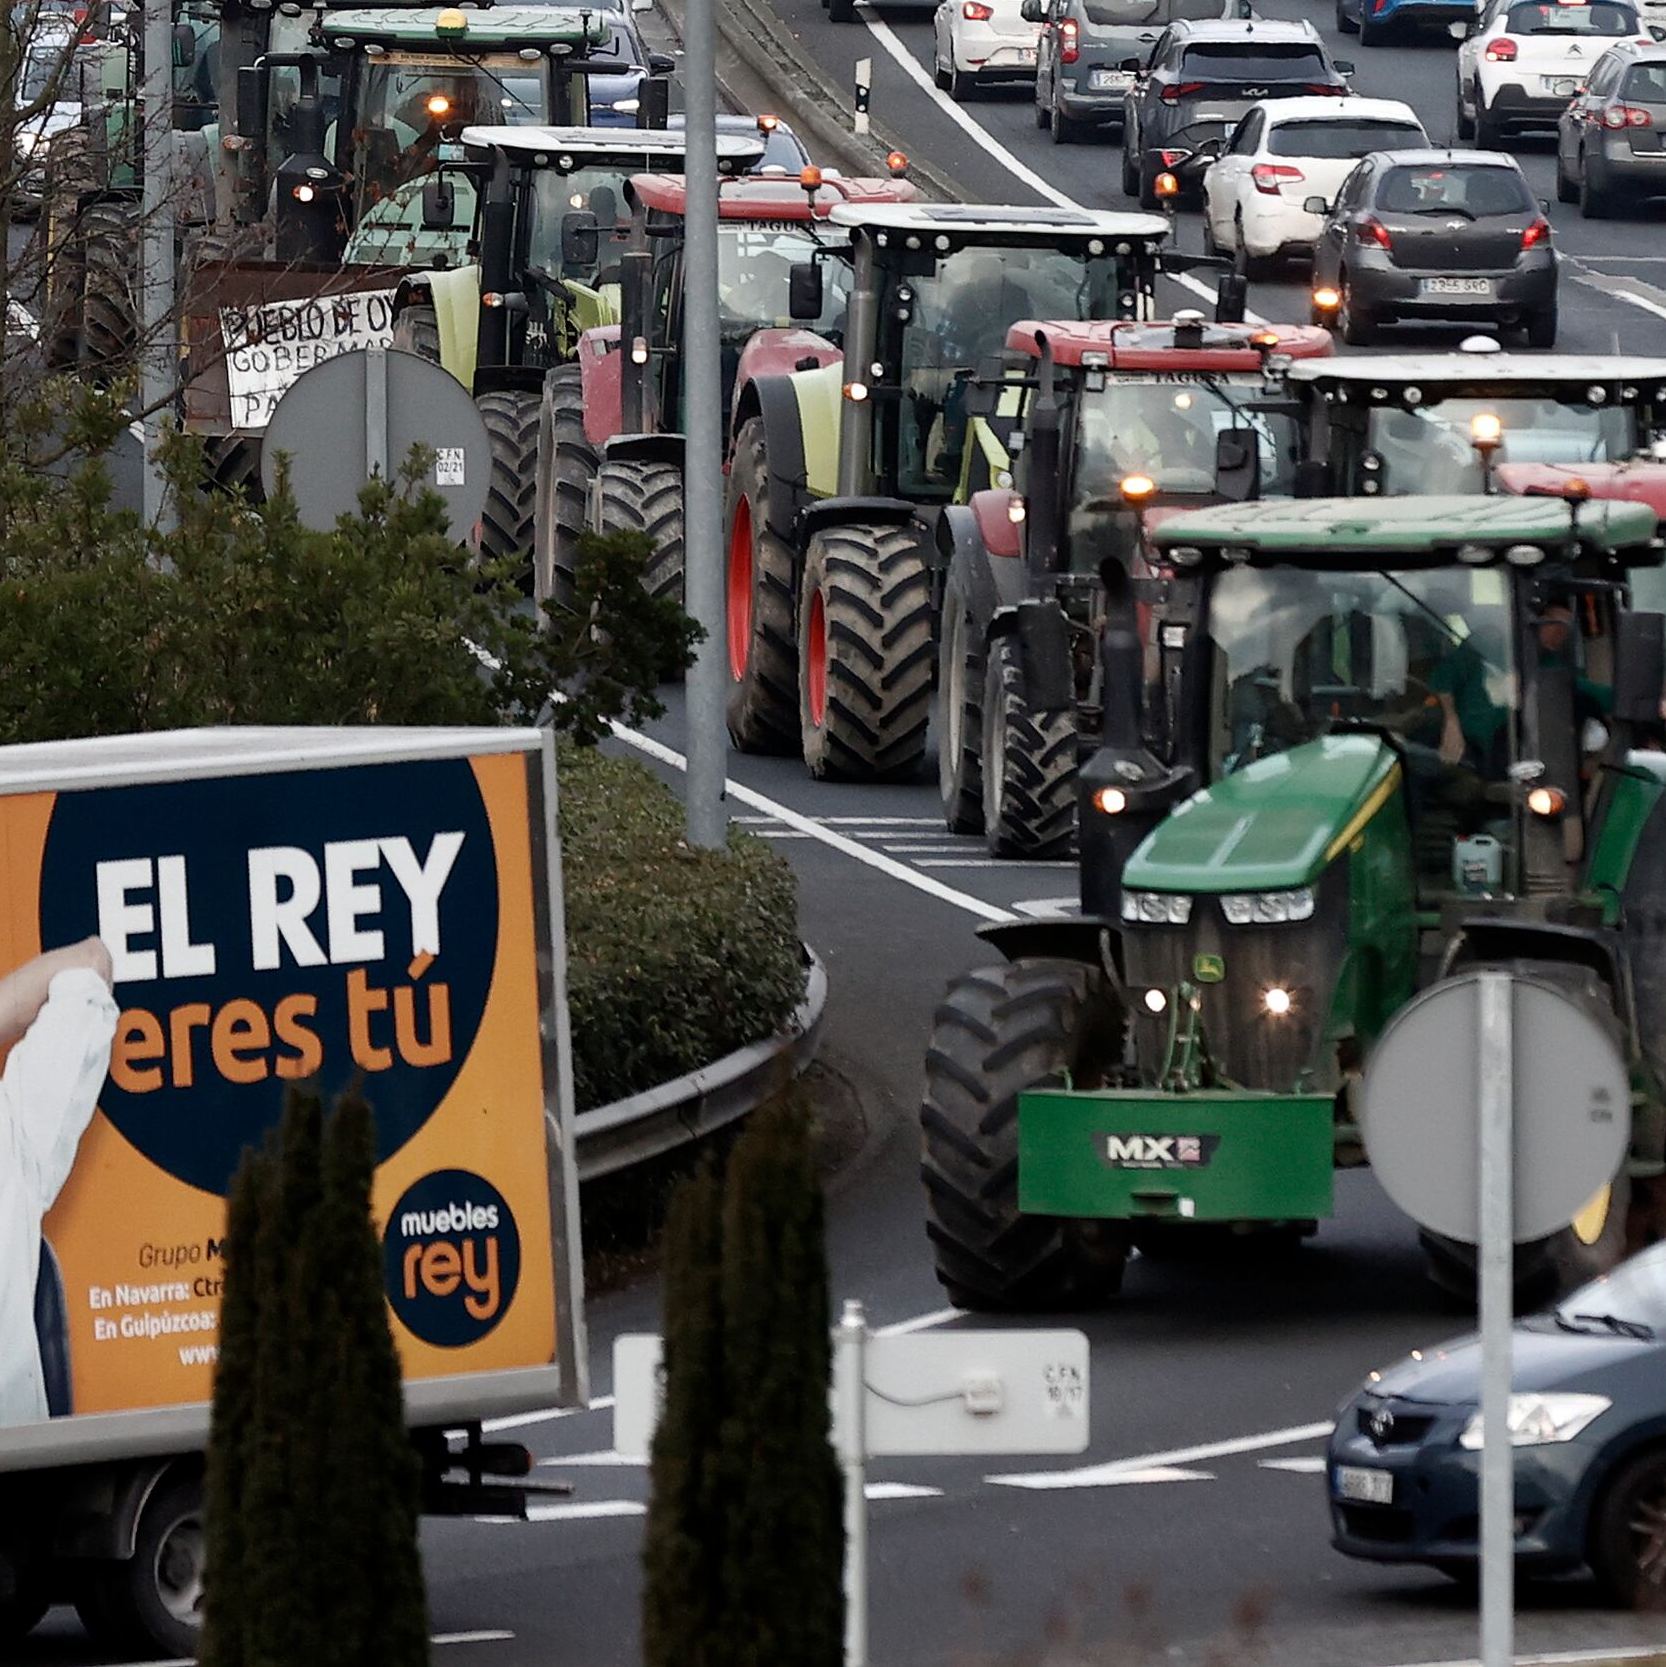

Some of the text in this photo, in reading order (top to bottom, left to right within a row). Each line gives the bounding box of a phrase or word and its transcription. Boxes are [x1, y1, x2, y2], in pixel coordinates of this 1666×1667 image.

[332, 296, 361, 335] DE
[437, 461, 464, 473] 02/21
[95, 830, 467, 984] EL REY
[109, 948, 453, 1094] eres tú
[1107, 1134, 1175, 1161] MX
[401, 1199, 500, 1237] muebles
[139, 1242, 201, 1270] Grupo
[89, 1286, 112, 1310] En
[115, 1282, 191, 1307] Navarra:
[403, 1236, 501, 1321] rey
[94, 1309, 217, 1341] En Guipúzcoa:
